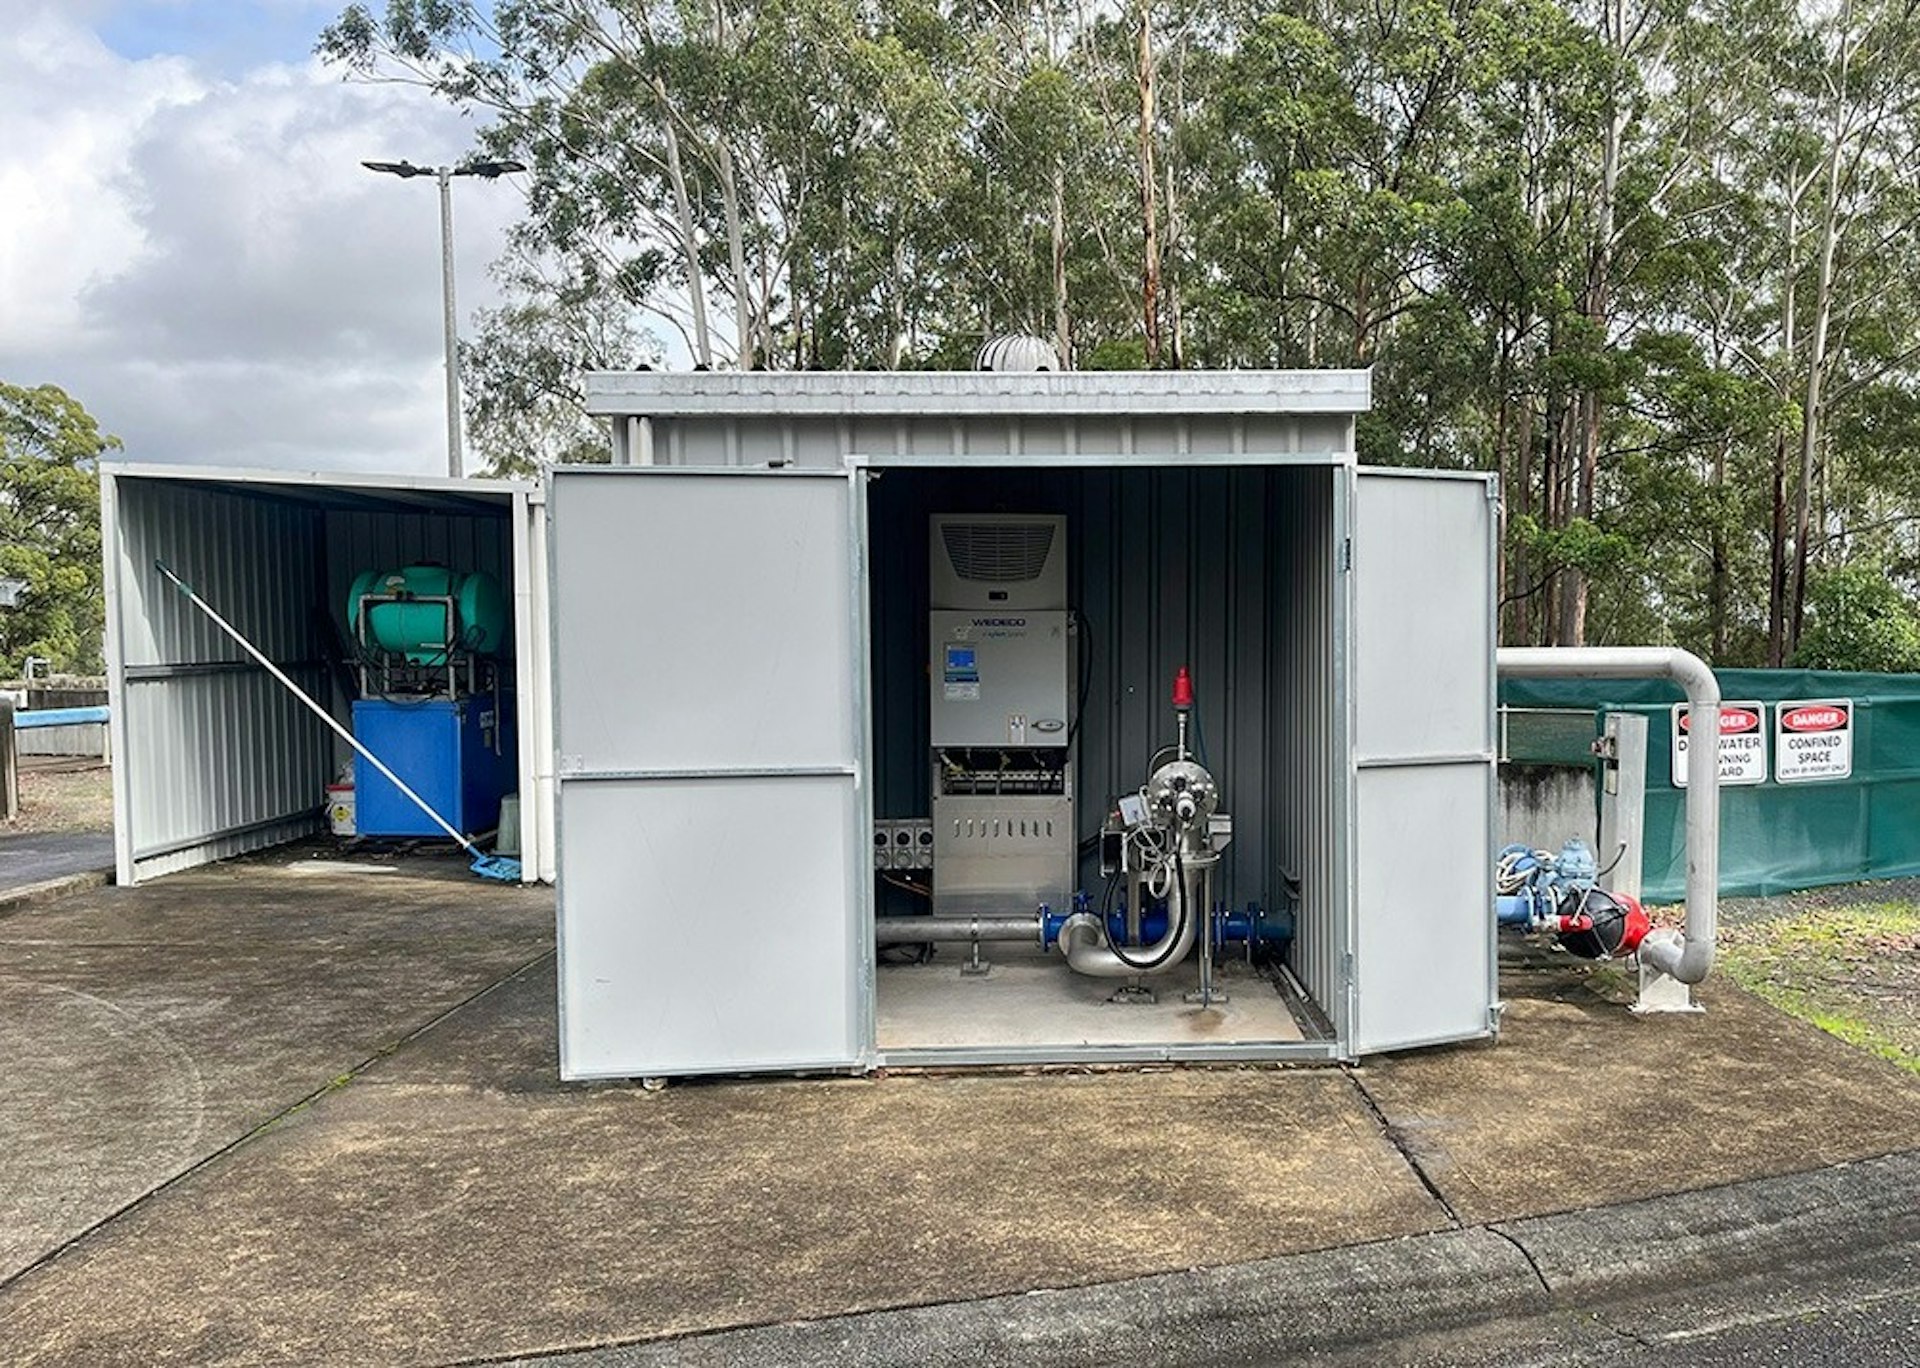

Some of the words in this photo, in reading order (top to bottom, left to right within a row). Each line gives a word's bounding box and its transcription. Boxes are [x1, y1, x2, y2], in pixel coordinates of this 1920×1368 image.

[1719, 714, 1747, 728] GER
[1792, 711, 1839, 727] DANGER
[1788, 735, 1842, 750] CONFINED
[1797, 750, 1831, 765] SPACE
[1719, 766, 1744, 777] ARD
